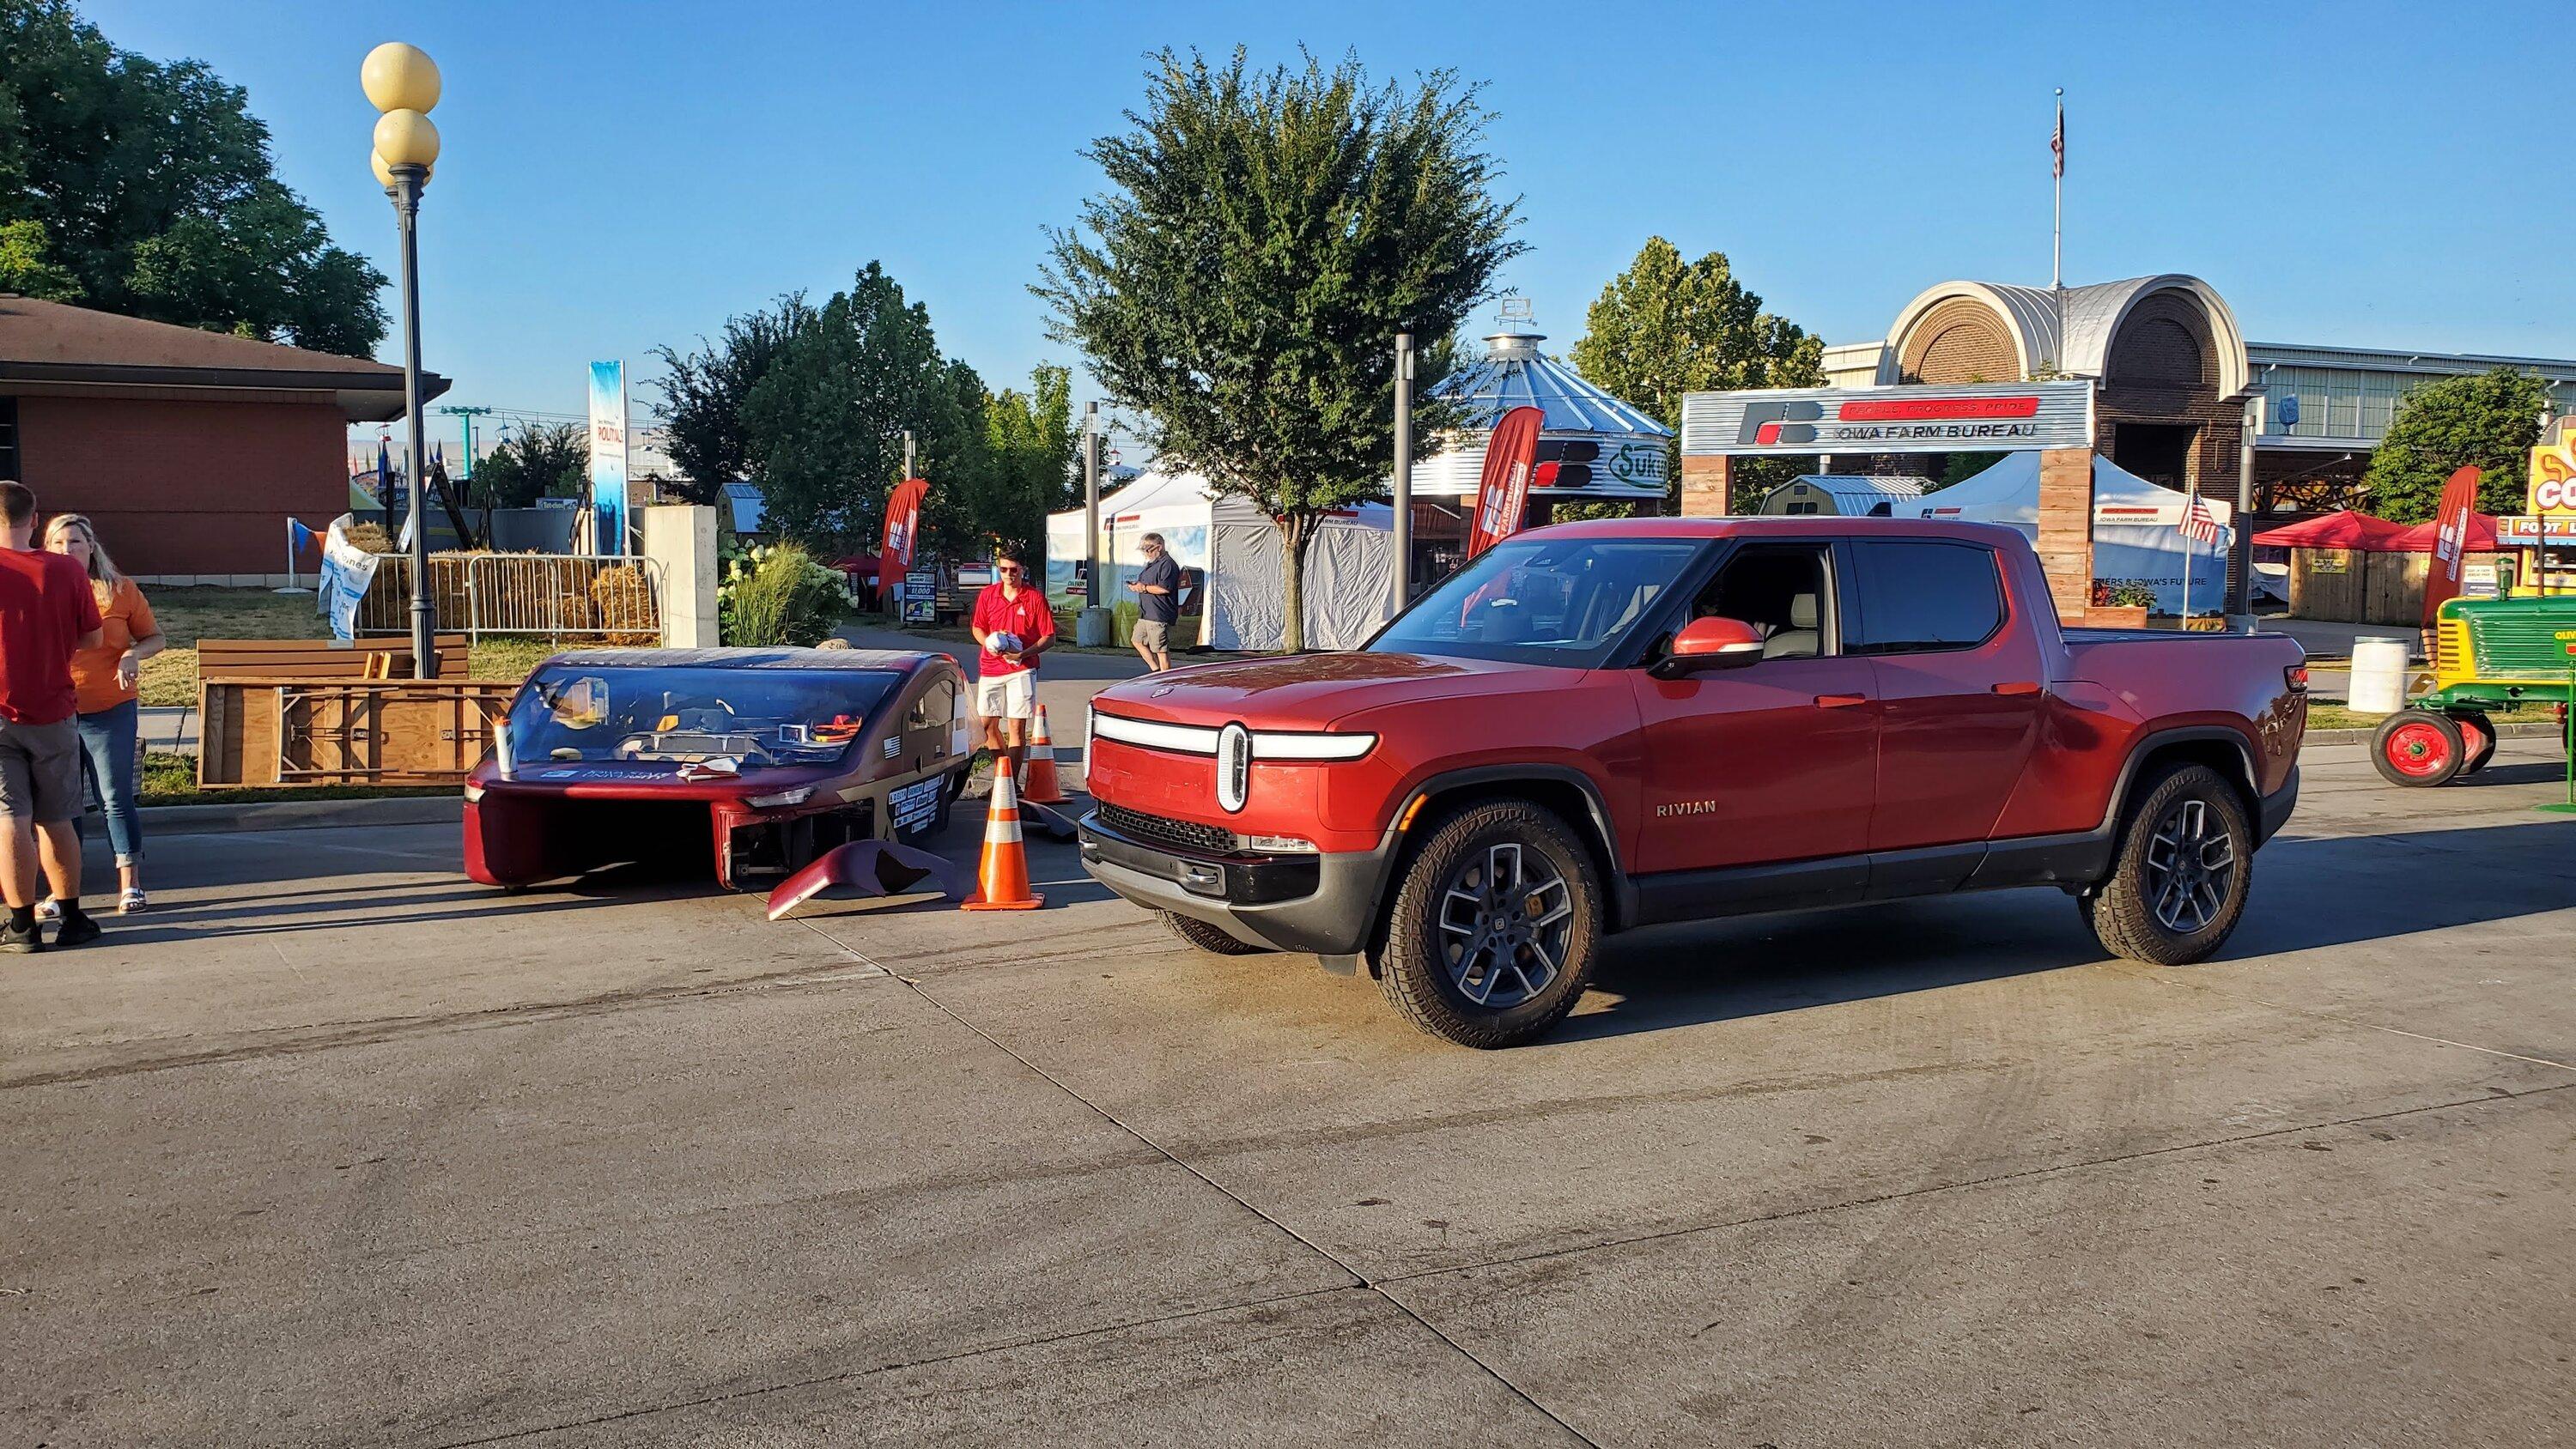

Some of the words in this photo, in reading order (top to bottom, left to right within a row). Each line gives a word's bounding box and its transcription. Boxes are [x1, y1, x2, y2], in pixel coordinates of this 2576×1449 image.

[1849, 405, 1902, 415] PEOPLE.
[1907, 403, 1980, 412] PROGRESS.
[1985, 403, 2029, 411] PRIDE.
[1886, 426, 1941, 439] FARM
[1947, 423, 2036, 437] BUREAU
[1501, 501, 1511, 531] FARM
[1506, 458, 1518, 501] BUREAU
[2519, 522, 2562, 534] FOOT
[2170, 577, 2208, 586] FUURE
[1656, 800, 1716, 817] RIVIAN
